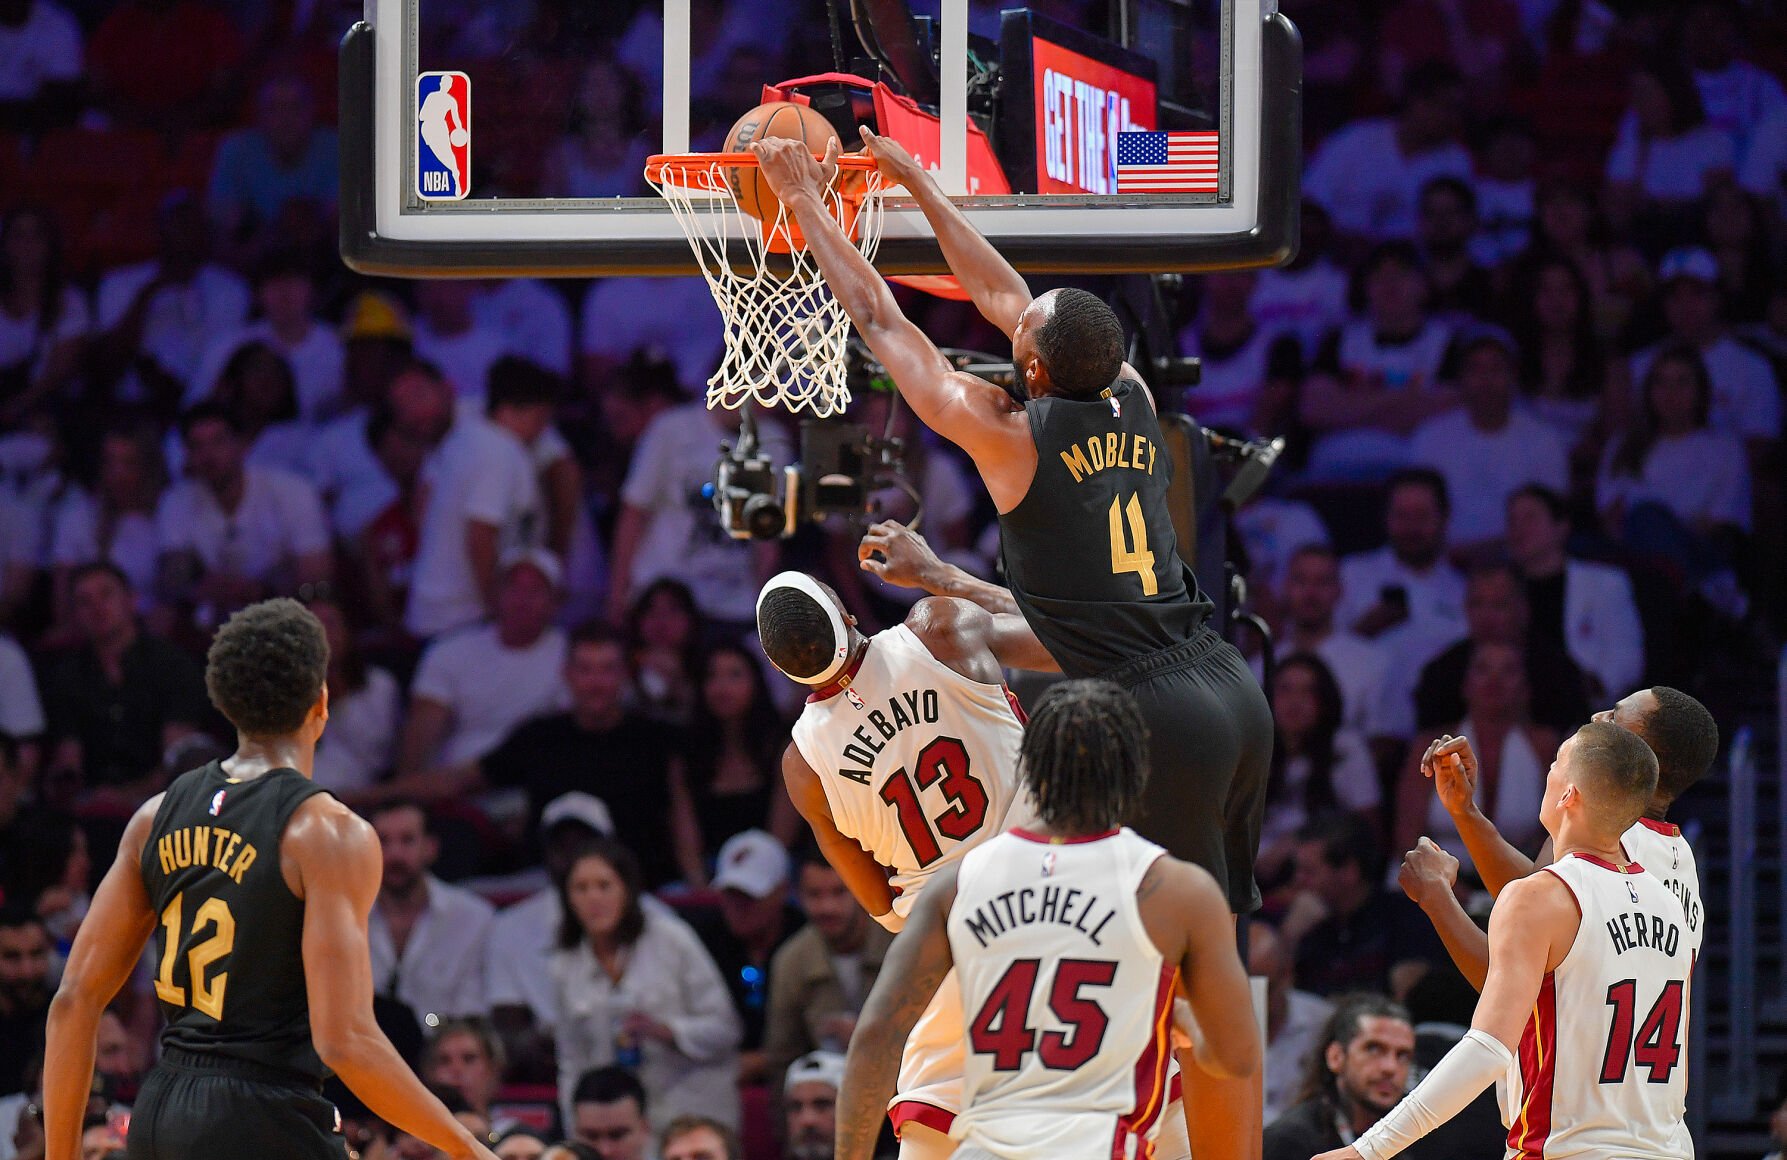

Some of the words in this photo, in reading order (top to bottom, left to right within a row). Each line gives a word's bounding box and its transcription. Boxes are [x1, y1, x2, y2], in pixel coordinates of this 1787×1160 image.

[731, 121, 761, 199] Wison
[1043, 67, 1074, 185] GET
[1074, 80, 1108, 195] THE
[423, 170, 451, 192] NBA
[1060, 431, 1157, 484] MOBLEY
[1108, 491, 1159, 597] 4
[838, 689, 940, 787] ADEBAYO
[878, 735, 990, 870] 13
[158, 826, 257, 885] HUNTER
[153, 890, 236, 1022] 12
[964, 885, 1117, 949] MITCHELL
[1606, 912, 1680, 958] HERRO
[969, 958, 1120, 1072] 45
[1598, 978, 1685, 1085] 14
